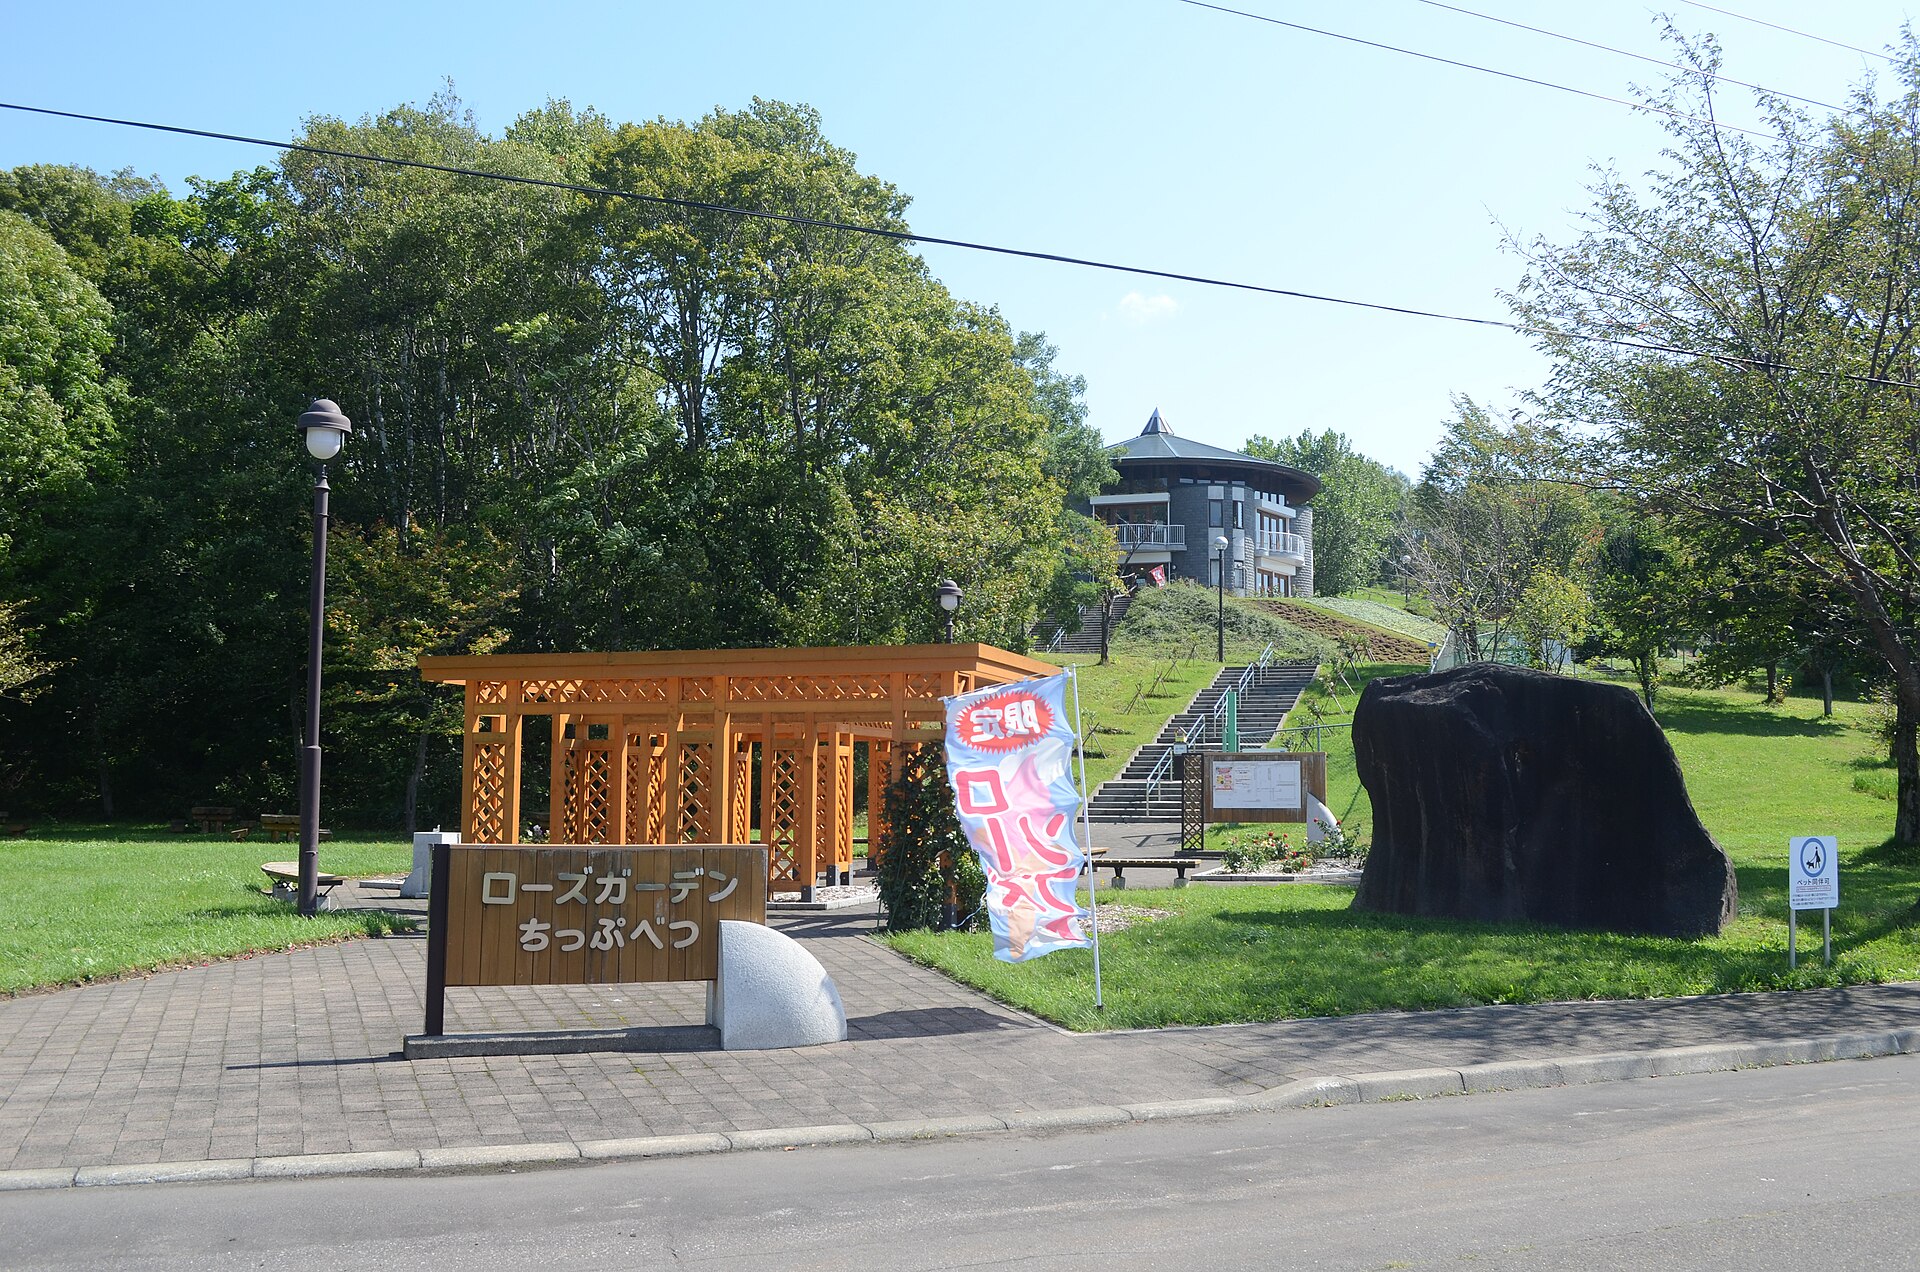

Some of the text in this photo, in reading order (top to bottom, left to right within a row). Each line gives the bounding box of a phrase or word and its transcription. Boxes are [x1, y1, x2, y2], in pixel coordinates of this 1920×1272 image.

[482, 866, 738, 905] ローズガーデン
[519, 917, 700, 952] ちっぷべつ
